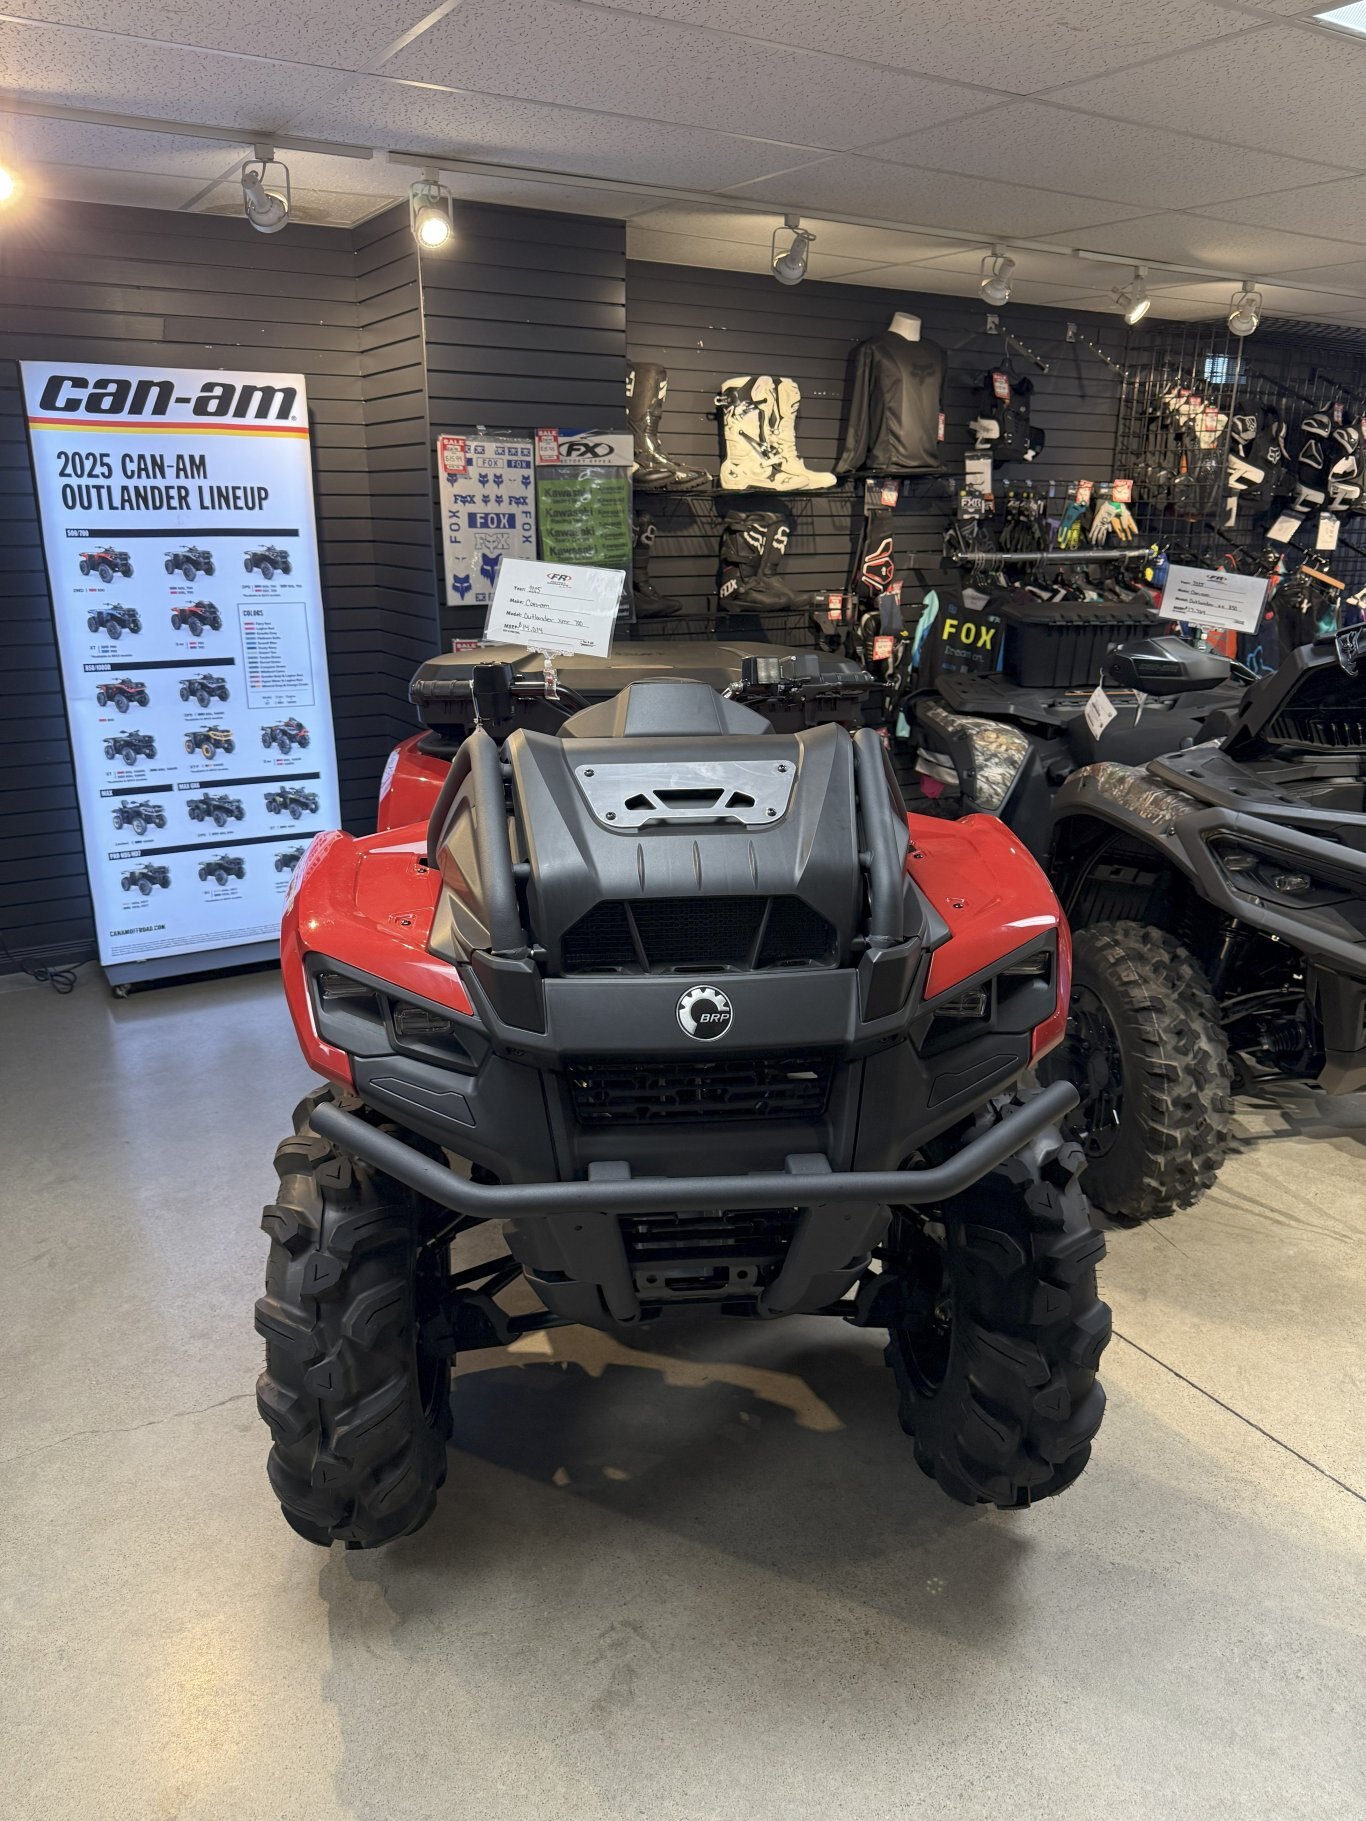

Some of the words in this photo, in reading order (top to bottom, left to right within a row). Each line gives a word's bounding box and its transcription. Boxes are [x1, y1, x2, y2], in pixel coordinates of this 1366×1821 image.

[39, 375, 297, 420] can-am
[565, 443, 602, 458] FX
[56, 451, 113, 480] 2025
[121, 452, 208, 480] CAN-AM
[483, 459, 499, 467] FOX
[61, 484, 191, 511] OUTLANDER
[199, 486, 269, 511] LINEUP
[448, 510, 461, 544] FOX
[476, 514, 511, 529] FOX
[522, 511, 533, 544] FOX
[67, 529, 89, 537] 500/700
[720, 579, 738, 598] FOX
[505, 610, 522, 618] Model:
[942, 619, 996, 650] FOX
[700, 1013, 730, 1022] BRP
